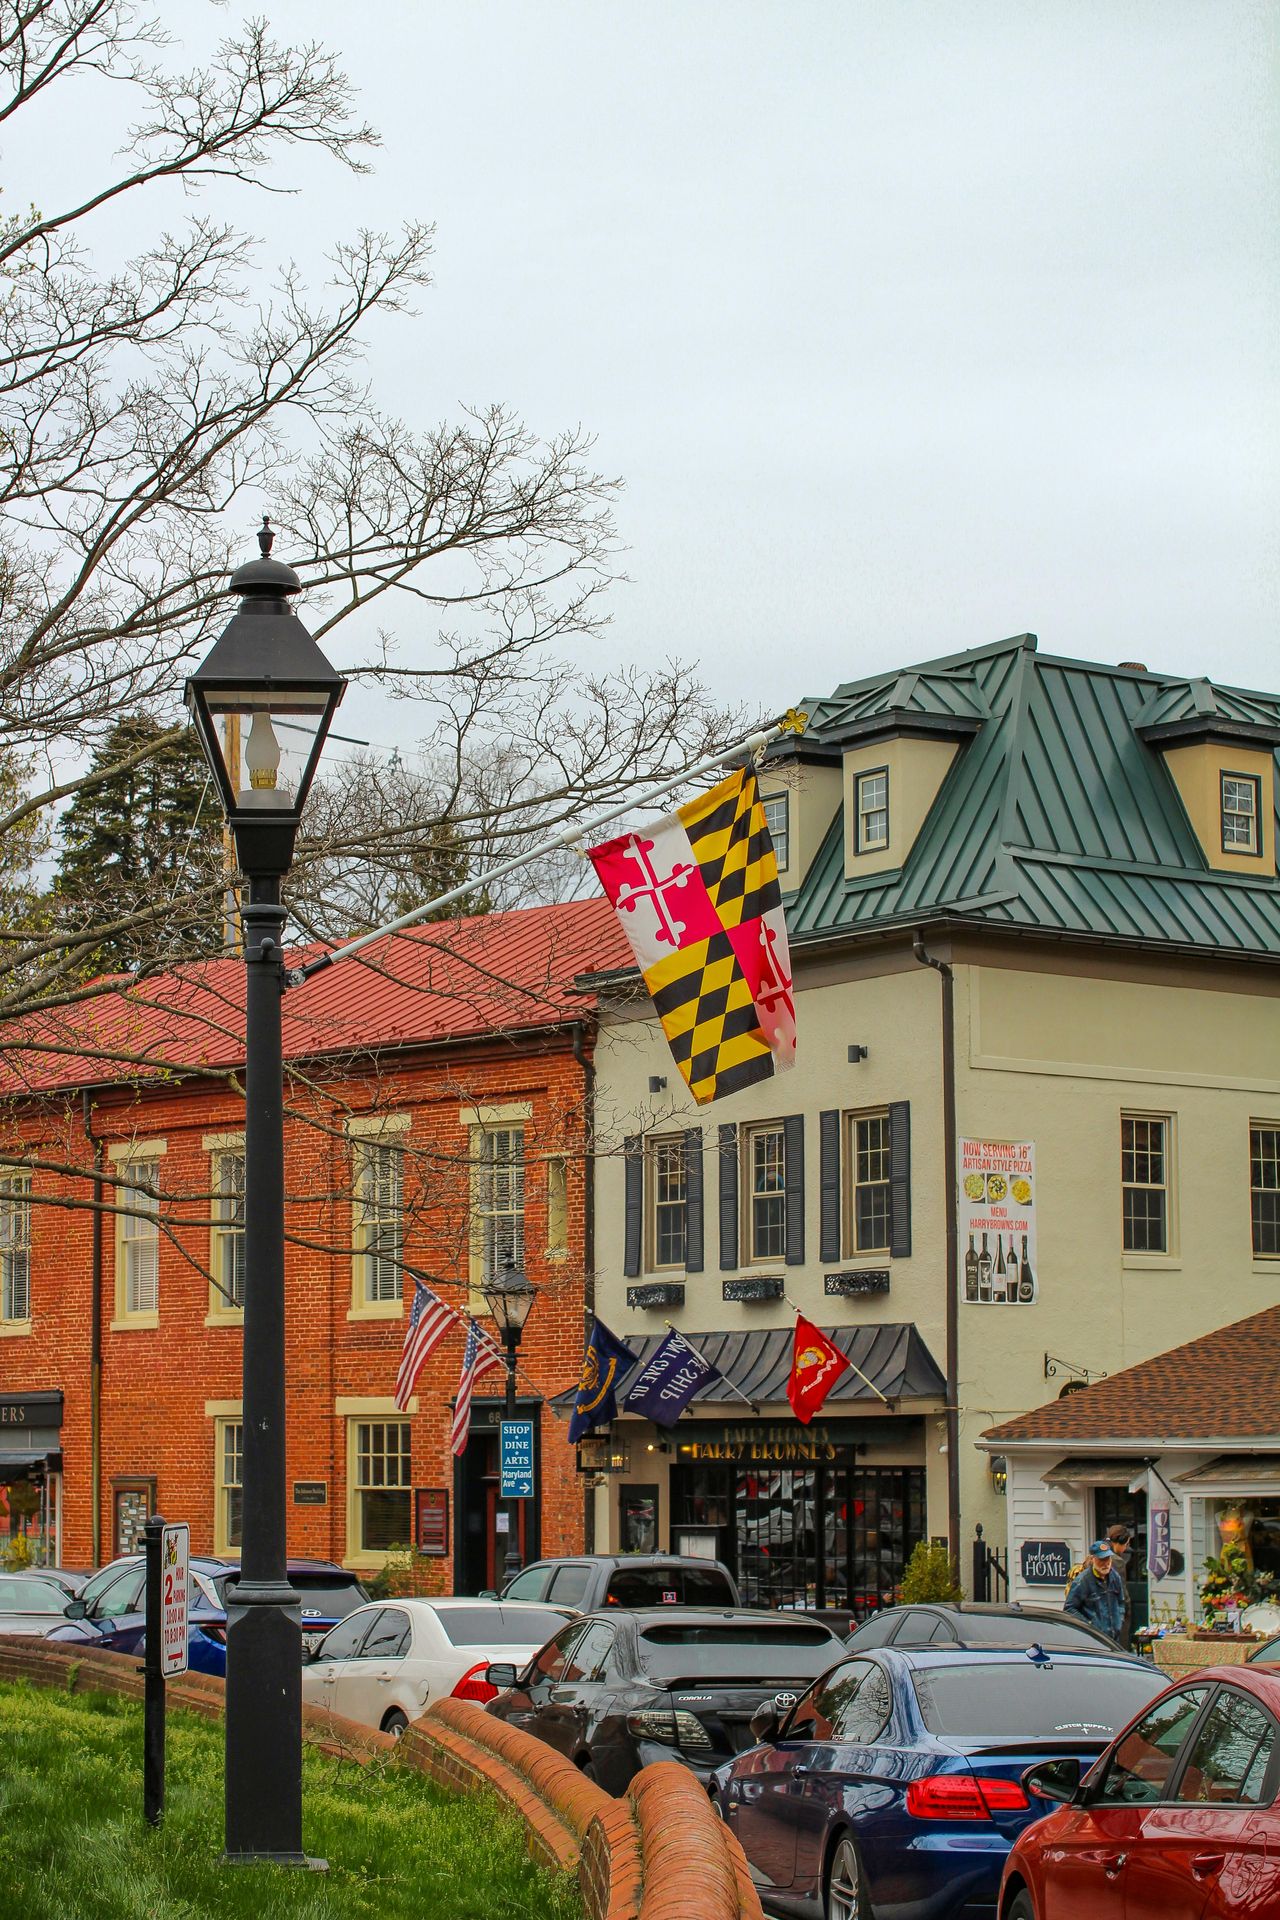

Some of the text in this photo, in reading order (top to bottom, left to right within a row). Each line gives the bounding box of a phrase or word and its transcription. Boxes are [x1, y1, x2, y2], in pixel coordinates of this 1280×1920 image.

[963, 1142, 981, 1156] NOW
[983, 1143, 1016, 1159] SERVING
[963, 1158, 1032, 1173] ARTISAN STYLE PIZZA
[991, 1207, 1007, 1217] MENU
[970, 1219, 1028, 1231] HARRYBROWNS.COM
[1, 1406, 25, 1421] ERS
[503, 1426, 530, 1434] SHOP
[505, 1441, 529, 1449] DINE
[691, 1443, 836, 1460] HARRY BROWNE'S
[505, 1456, 529, 1464] ARTS
[502, 1470, 532, 1480] Maryland
[503, 1480, 515, 1488] Ave
[1154, 1511, 1169, 1573] OPEN
[1027, 1543, 1063, 1563] welcome
[175, 1567, 184, 1580] HOUR
[1025, 1561, 1067, 1577] HOME
[165, 1574, 173, 1605] 2
[173, 1588, 185, 1602] PARKING
[166, 1606, 184, 1625] 10:00 AM
[164, 1628, 170, 1645] TO
[179, 1625, 185, 1641] PM
